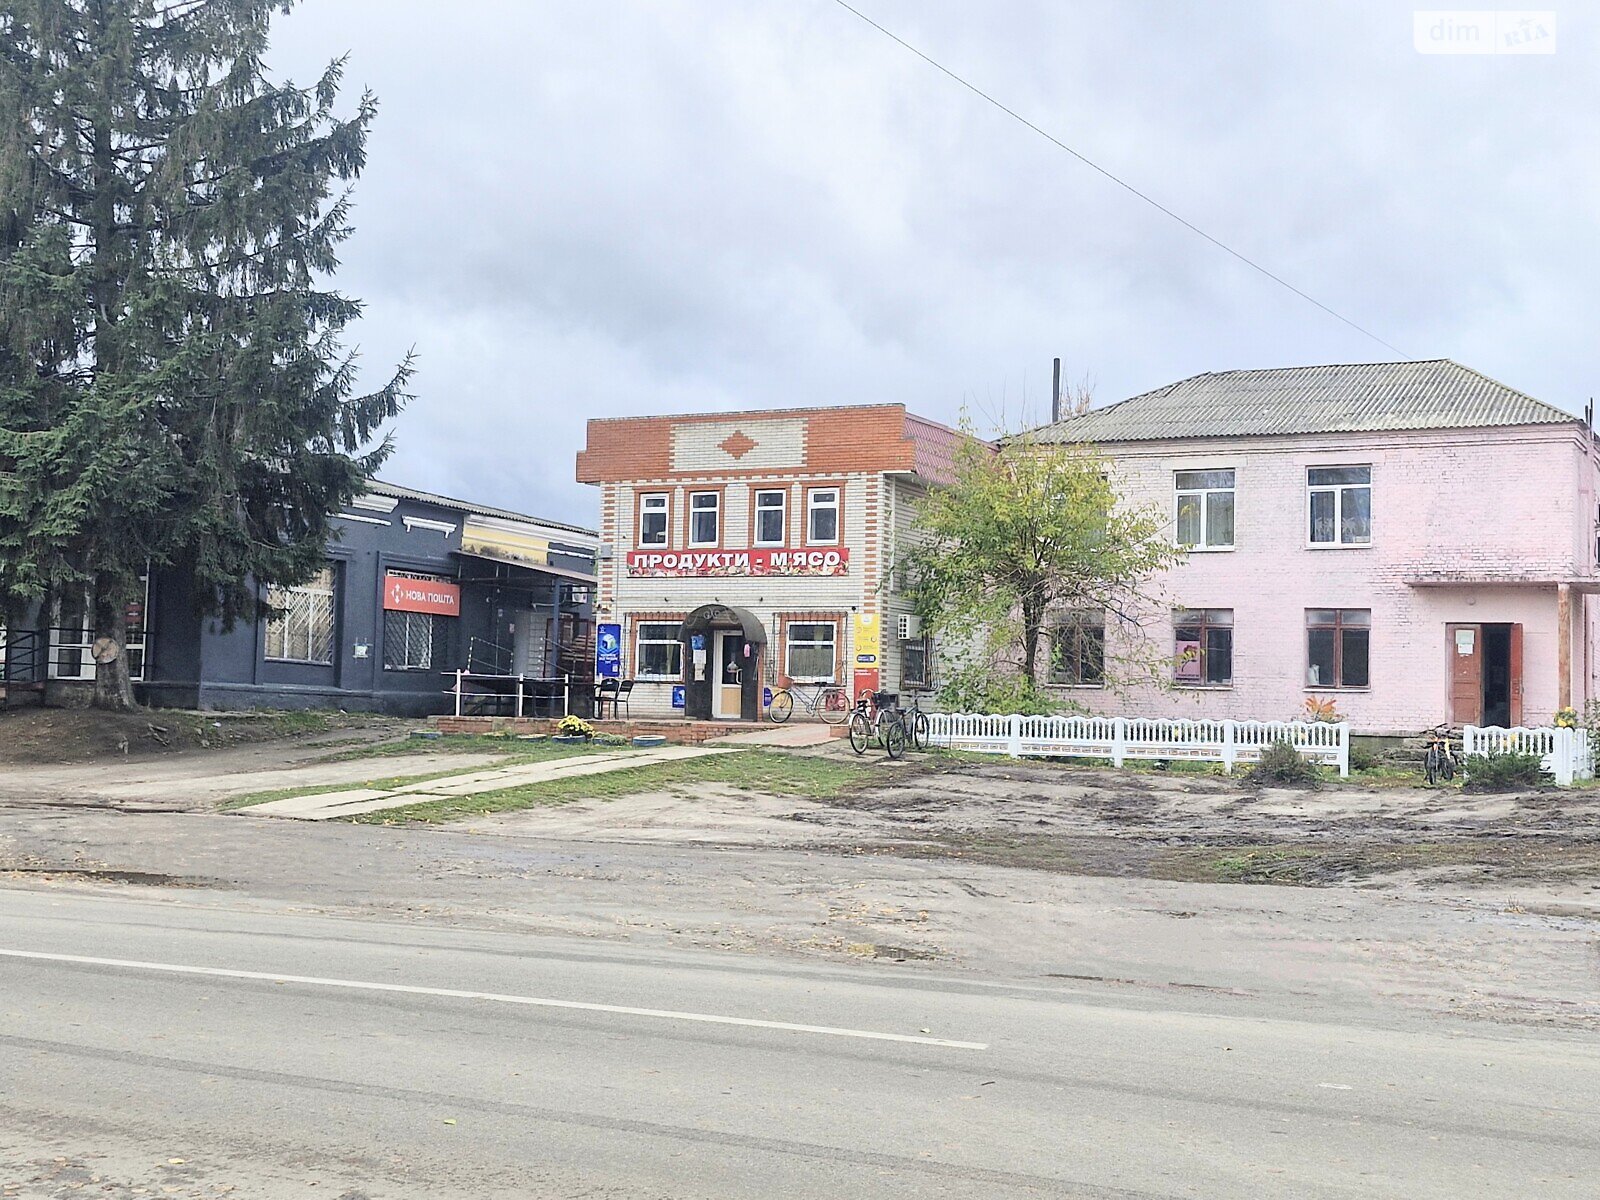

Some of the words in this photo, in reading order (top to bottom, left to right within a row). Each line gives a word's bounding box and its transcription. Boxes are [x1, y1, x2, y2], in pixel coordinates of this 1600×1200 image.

[634, 553, 749, 570] ПРОДУКТИ
[770, 551, 840, 566] М'ЯСО
[405, 590, 426, 602] НОВА
[427, 592, 454, 604] ПОШТА
